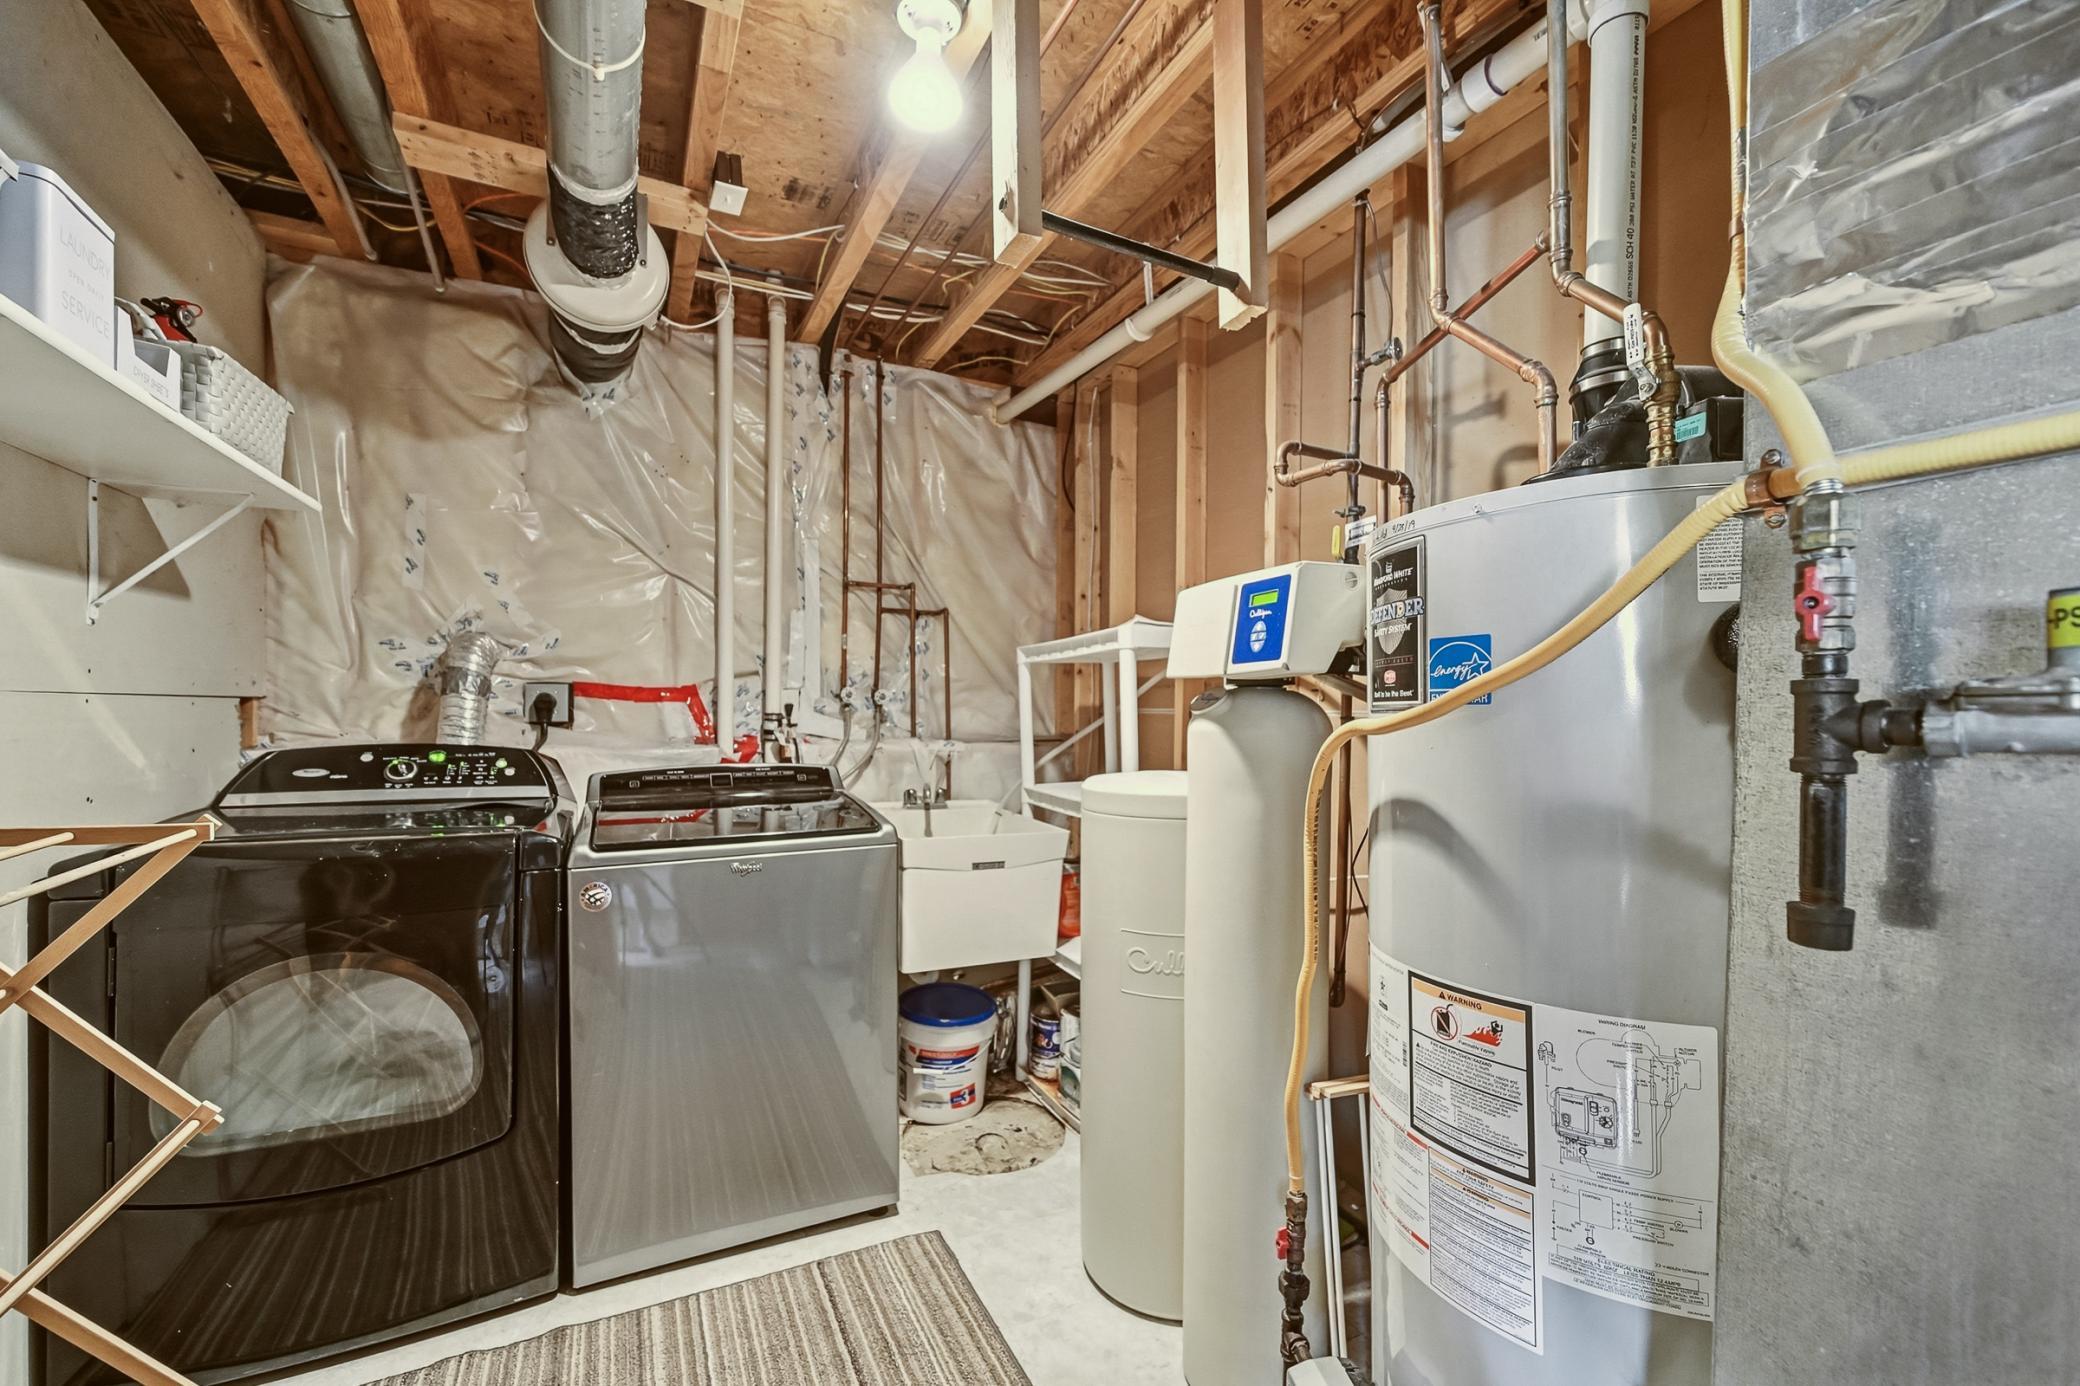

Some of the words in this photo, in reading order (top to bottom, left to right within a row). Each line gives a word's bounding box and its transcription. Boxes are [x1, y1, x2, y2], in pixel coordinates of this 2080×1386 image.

[1626, 228, 1635, 240] 40
[59, 225, 111, 280] LAUNDRY
[1625, 241, 1634, 260] SCH
[61, 291, 110, 339] SERVICE
[1393, 569, 1411, 579] WHITE
[1371, 597, 1425, 624] DEFENDER
[1430, 665, 1470, 681] energy
[1446, 993, 1482, 1010] WARNING
[1598, 1019, 1619, 1027] WIRING
